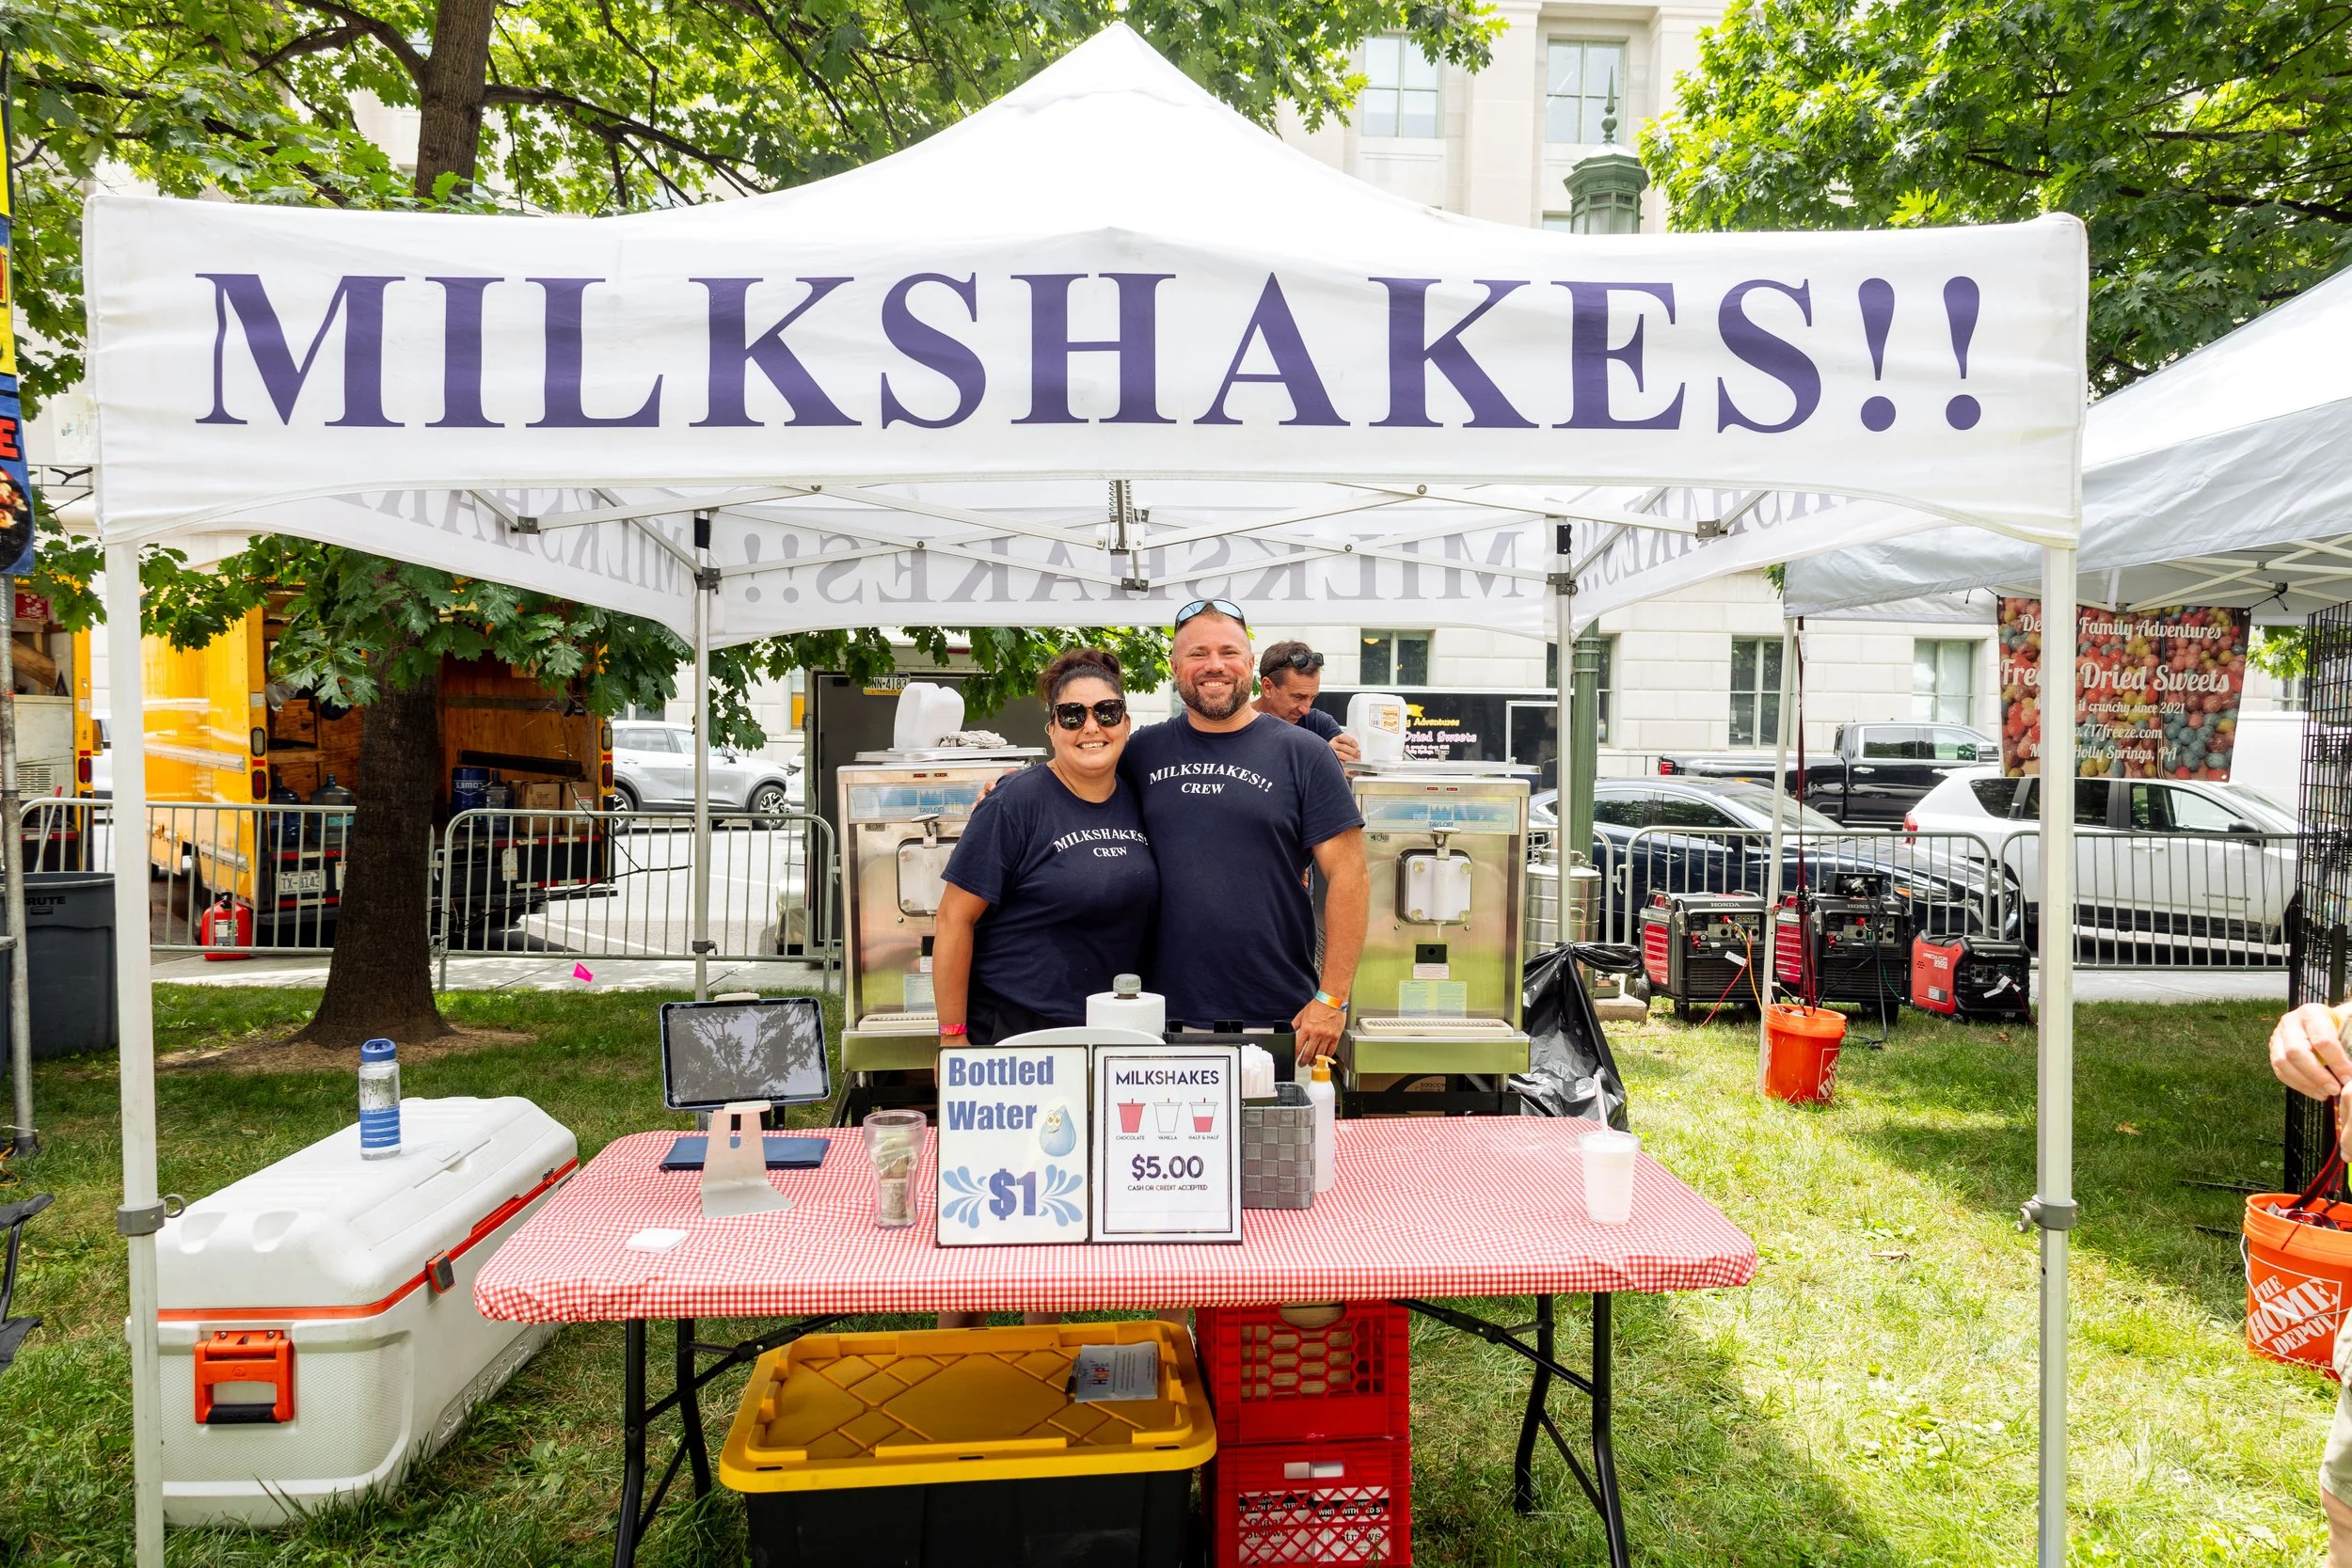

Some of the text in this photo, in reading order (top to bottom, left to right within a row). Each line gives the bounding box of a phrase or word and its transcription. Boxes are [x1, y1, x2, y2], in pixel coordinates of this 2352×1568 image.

[195, 272, 1982, 434] MILKSHAKES!!
[2078, 616, 2133, 641] Family
[2136, 619, 2221, 640] Adventures
[2080, 662, 2146, 690] Dried
[2153, 664, 2230, 692] Sweets
[2088, 702, 2130, 716] crunchy
[2133, 703, 2157, 713] since
[2159, 702, 2185, 714] 2021
[1437, 731, 1477, 743] Sweets
[2074, 743, 2104, 761] Holly
[2106, 745, 2154, 763] Springs,
[2158, 747, 2177, 761] PA
[1149, 763, 1273, 793] MILKSHAKES!!
[1181, 782, 1225, 794] CREW
[1093, 847, 1127, 858] CREW
[24, 895, 66, 906] RUTE
[947, 1055, 1054, 1086] Bottled
[1116, 1069, 1219, 1085] MILKSHAKES
[946, 1101, 1038, 1131] Water
[1132, 1154, 1204, 1181] $5.00
[988, 1168, 1037, 1221] $1
[2255, 1275, 2285, 1301] THE
[2248, 1278, 2339, 1345] HOME
[2270, 1315, 2336, 1355] DEPOT
